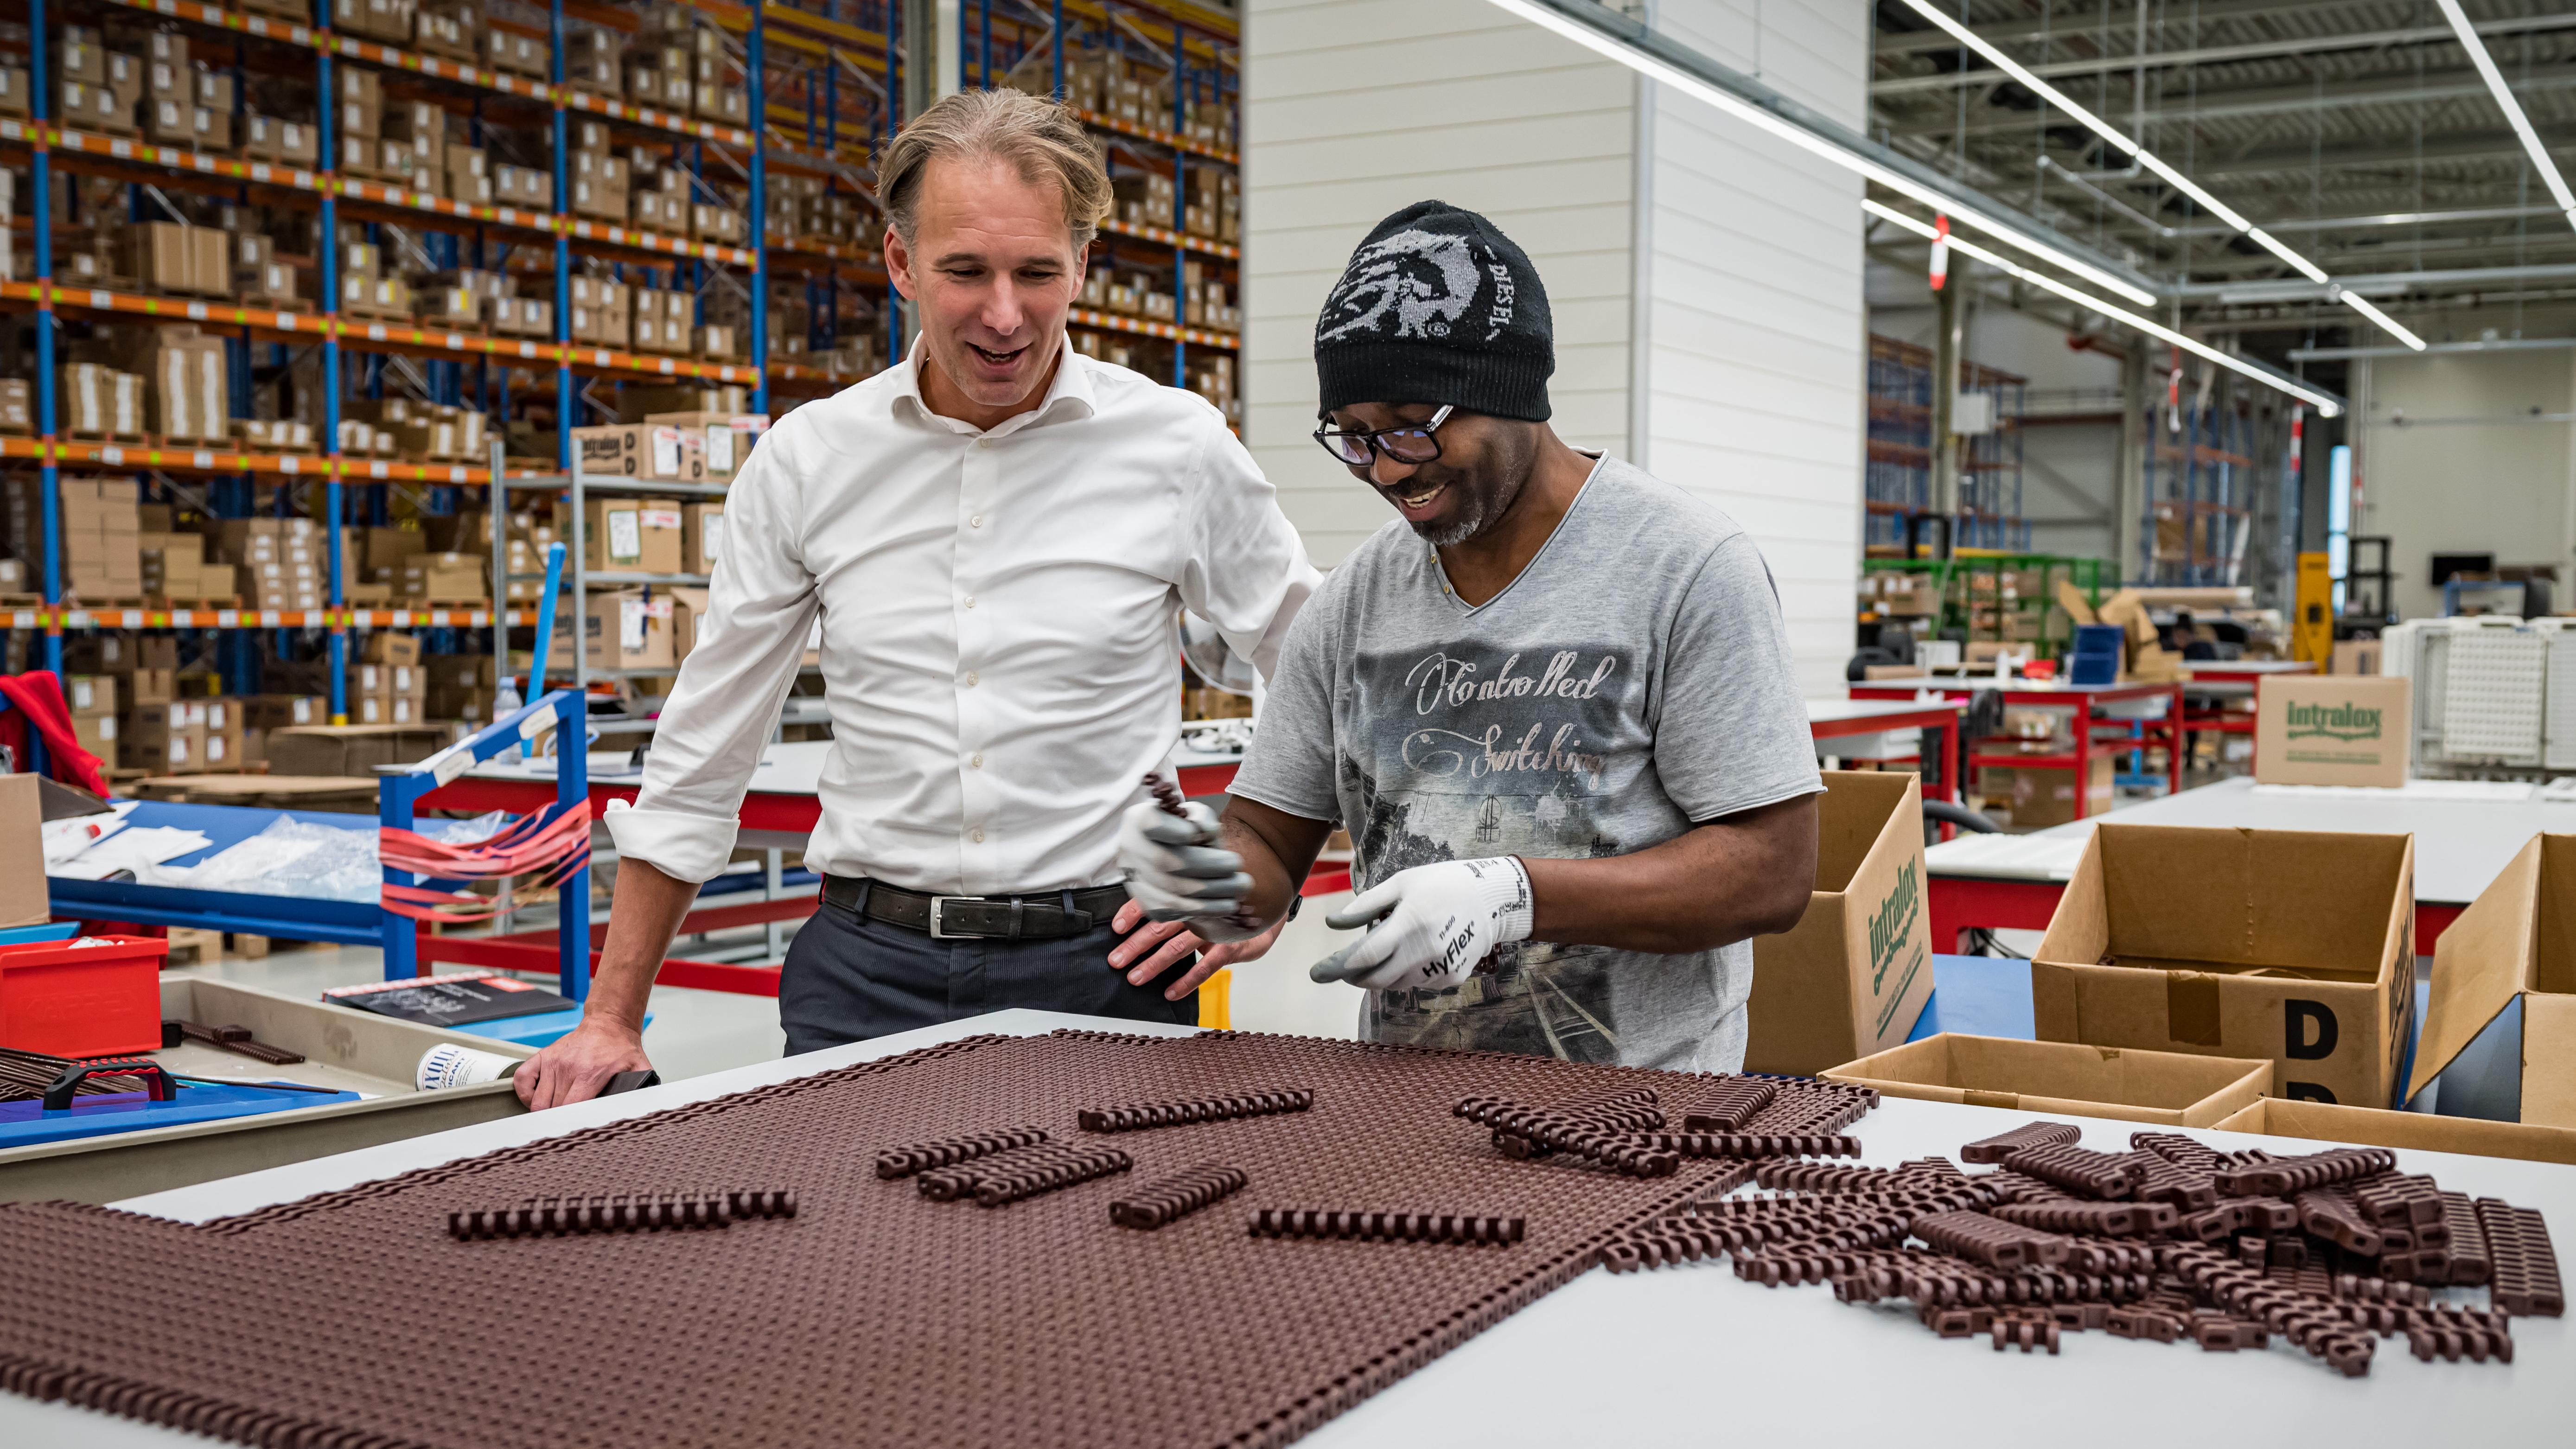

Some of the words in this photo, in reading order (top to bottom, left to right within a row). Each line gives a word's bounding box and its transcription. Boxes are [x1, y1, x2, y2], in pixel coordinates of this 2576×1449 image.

[1488, 263, 1514, 326] DIESEL
[1405, 650, 1616, 715] Controlled
[1868, 853, 1918, 970] intralox
[2285, 999, 2339, 1060] D
